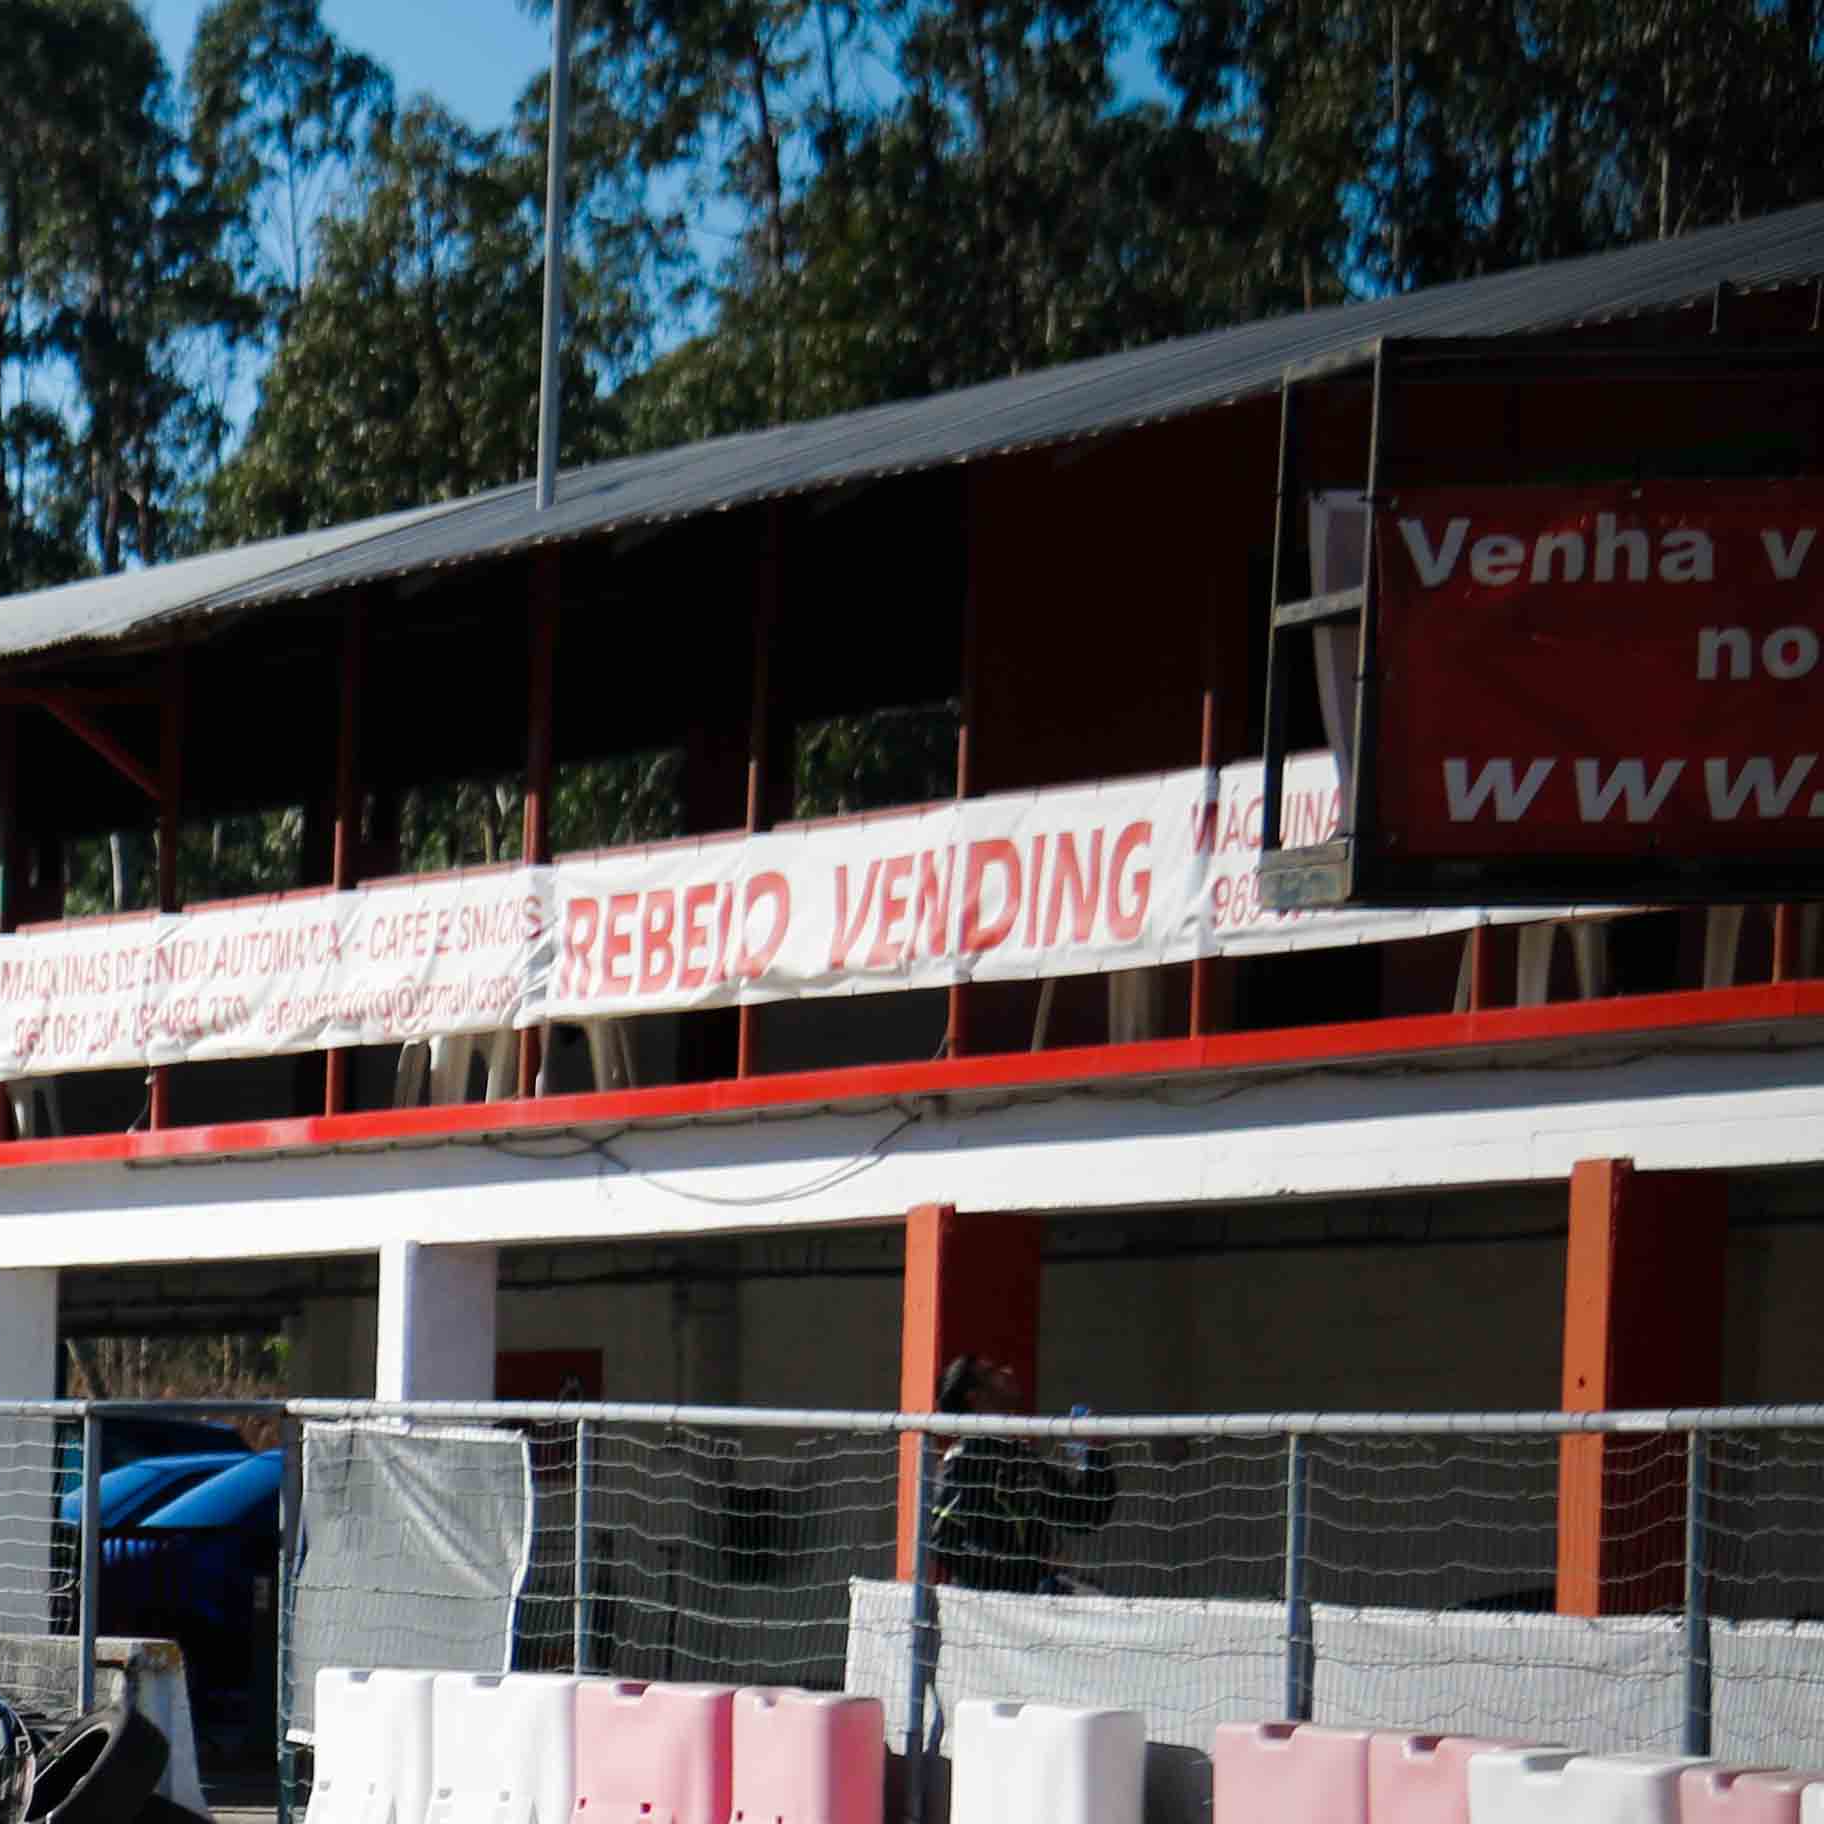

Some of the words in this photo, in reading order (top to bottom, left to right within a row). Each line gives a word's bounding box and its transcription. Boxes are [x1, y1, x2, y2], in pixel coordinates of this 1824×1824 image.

[1399, 513, 1713, 588] Venha
[1696, 624, 1820, 680] no
[557, 869, 791, 1001] REBELO
[828, 820, 1153, 971] VENDING
